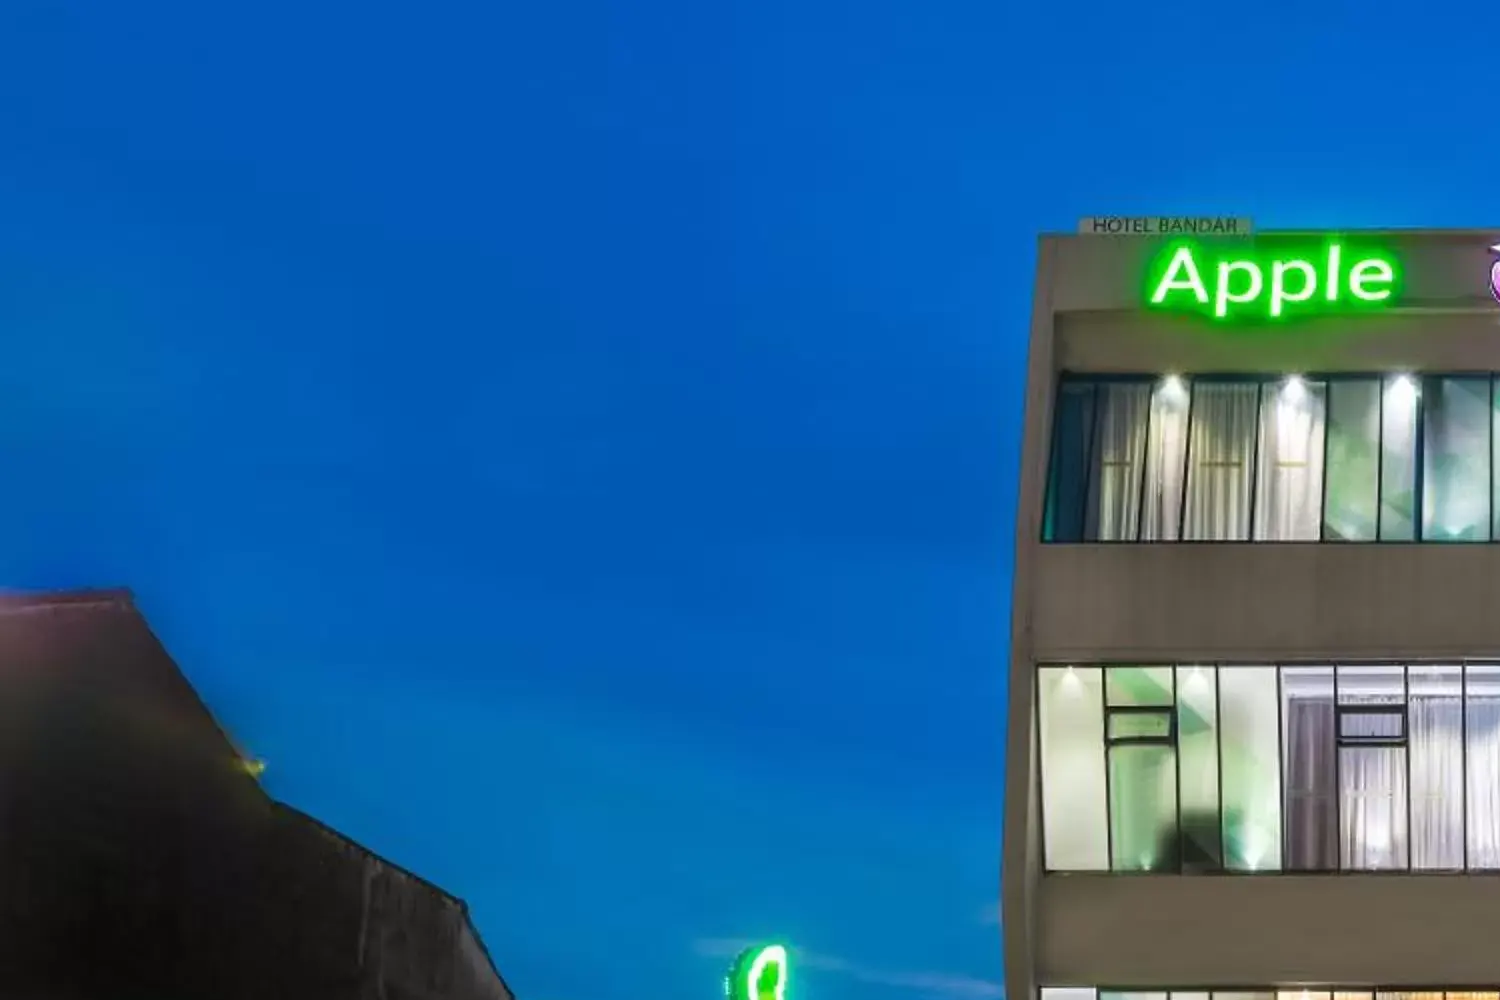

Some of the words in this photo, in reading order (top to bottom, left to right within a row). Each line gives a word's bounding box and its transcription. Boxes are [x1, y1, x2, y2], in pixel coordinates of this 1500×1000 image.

[1093, 216, 1153, 233] HOTEL
[1159, 216, 1238, 233] BANDAR
[1151, 245, 1394, 317] Apple
